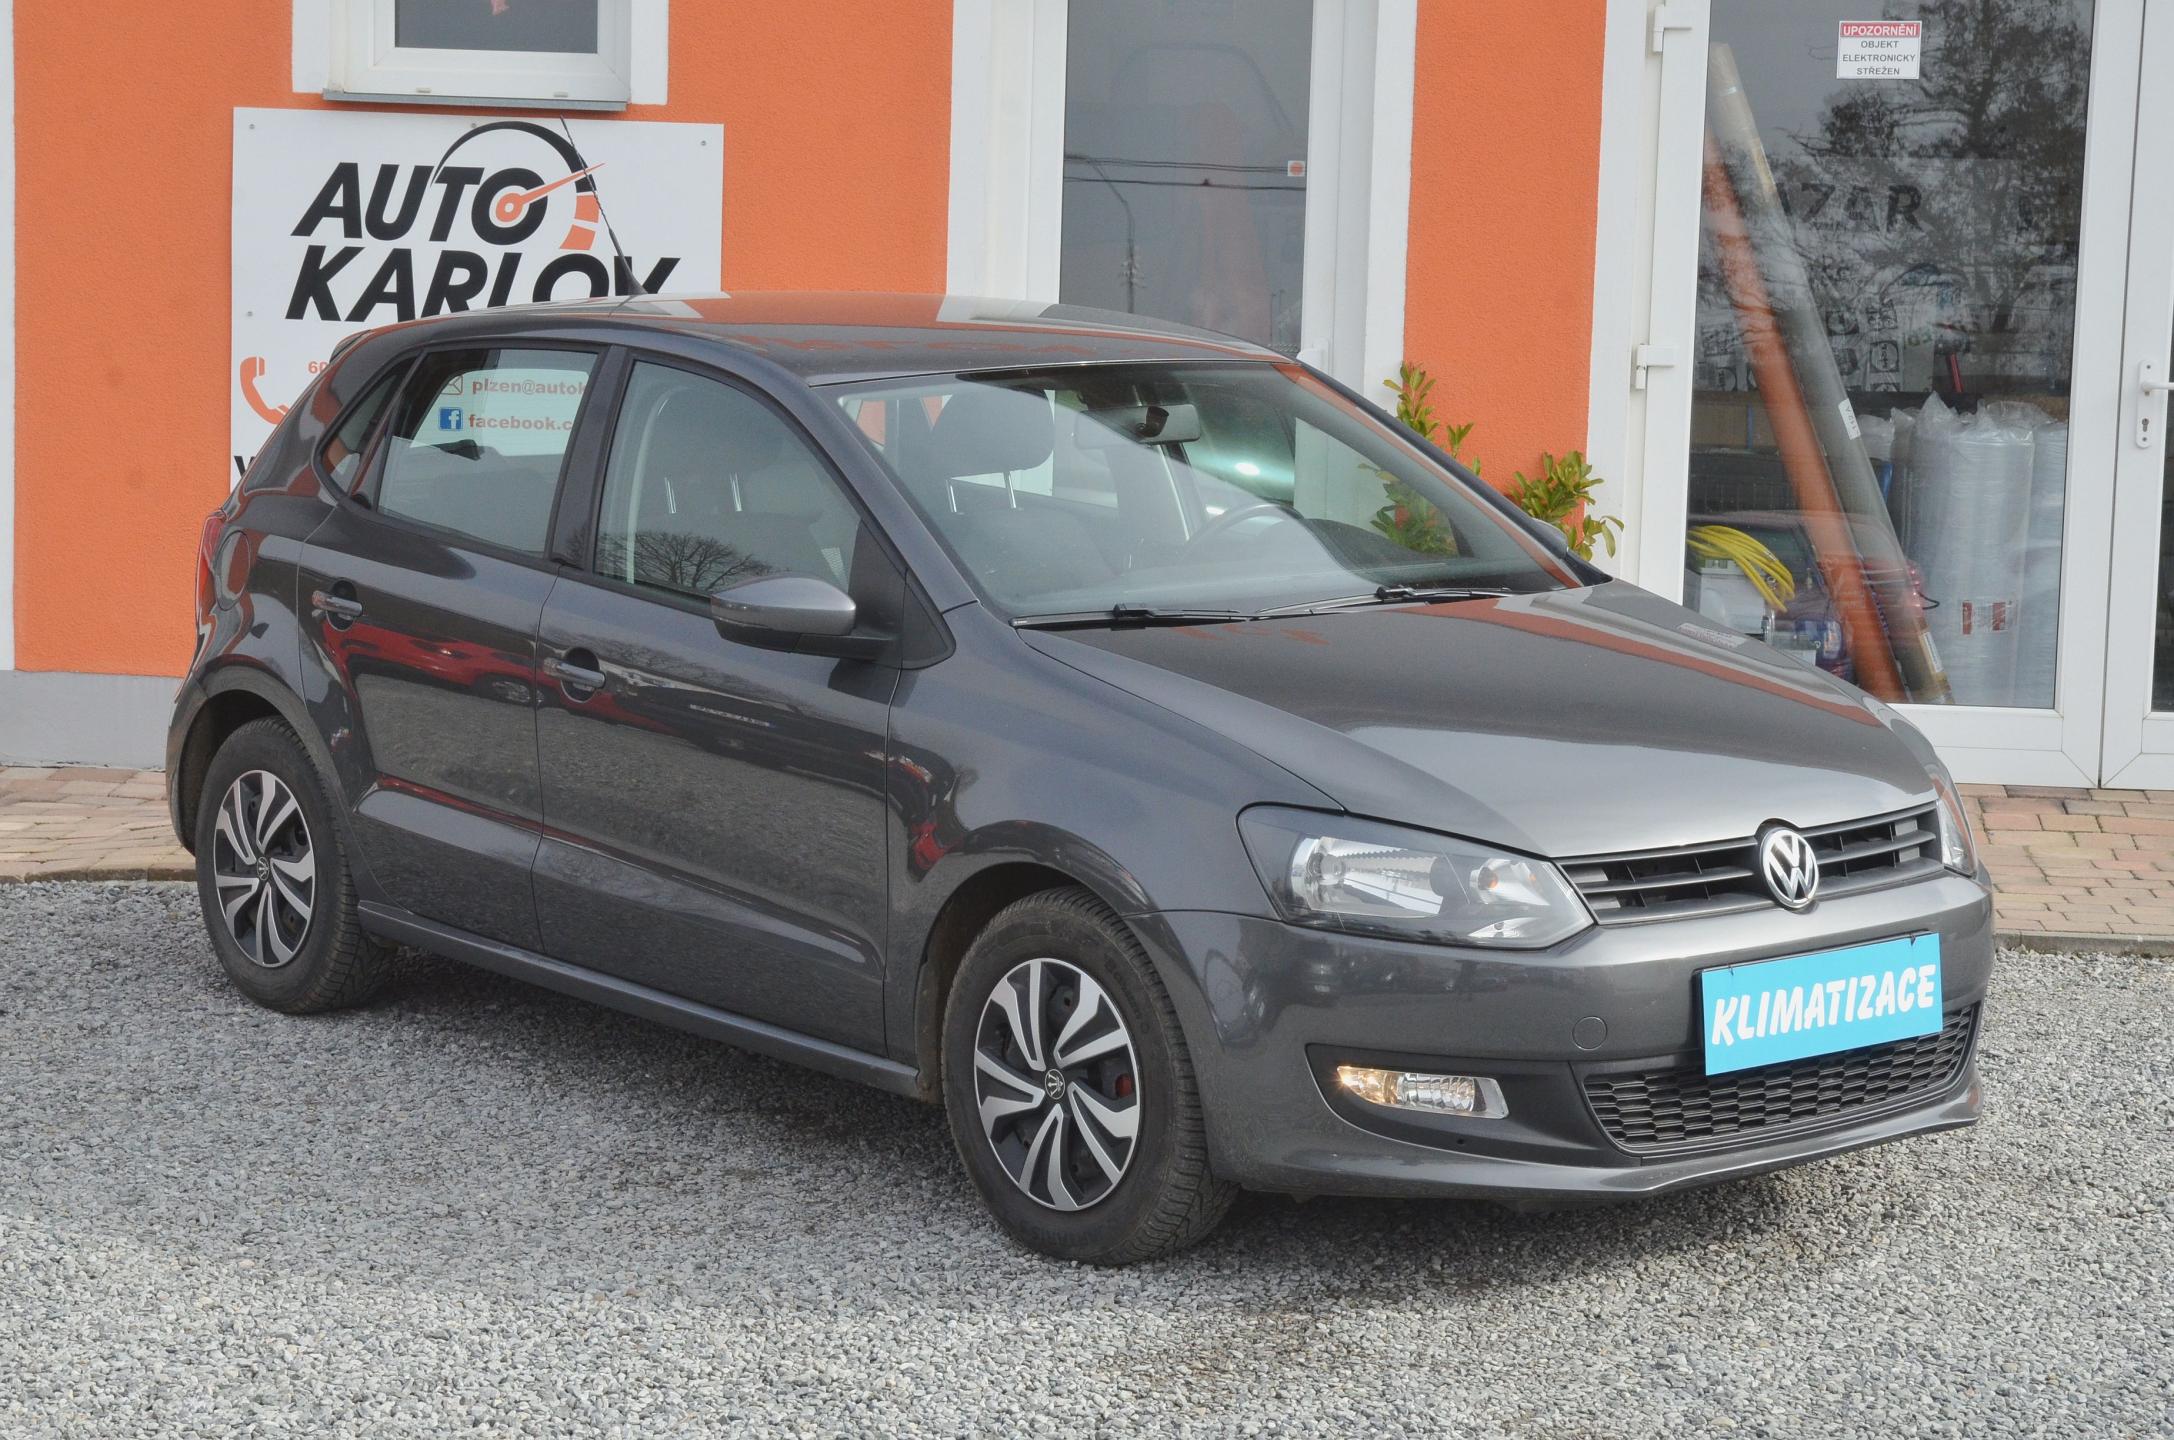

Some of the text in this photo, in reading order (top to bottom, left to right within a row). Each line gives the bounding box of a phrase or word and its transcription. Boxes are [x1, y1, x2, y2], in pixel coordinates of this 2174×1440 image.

[1843, 24, 1917, 36] UPOZORNĚNÍ
[1860, 40, 1899, 49] OBJEKT
[1842, 54, 1916, 62] ELEKTRONICKY
[1856, 66, 1900, 75] STŘEŽEN
[290, 162, 549, 246] AUTO
[1711, 964, 1937, 1046] KLIMATIZACE
